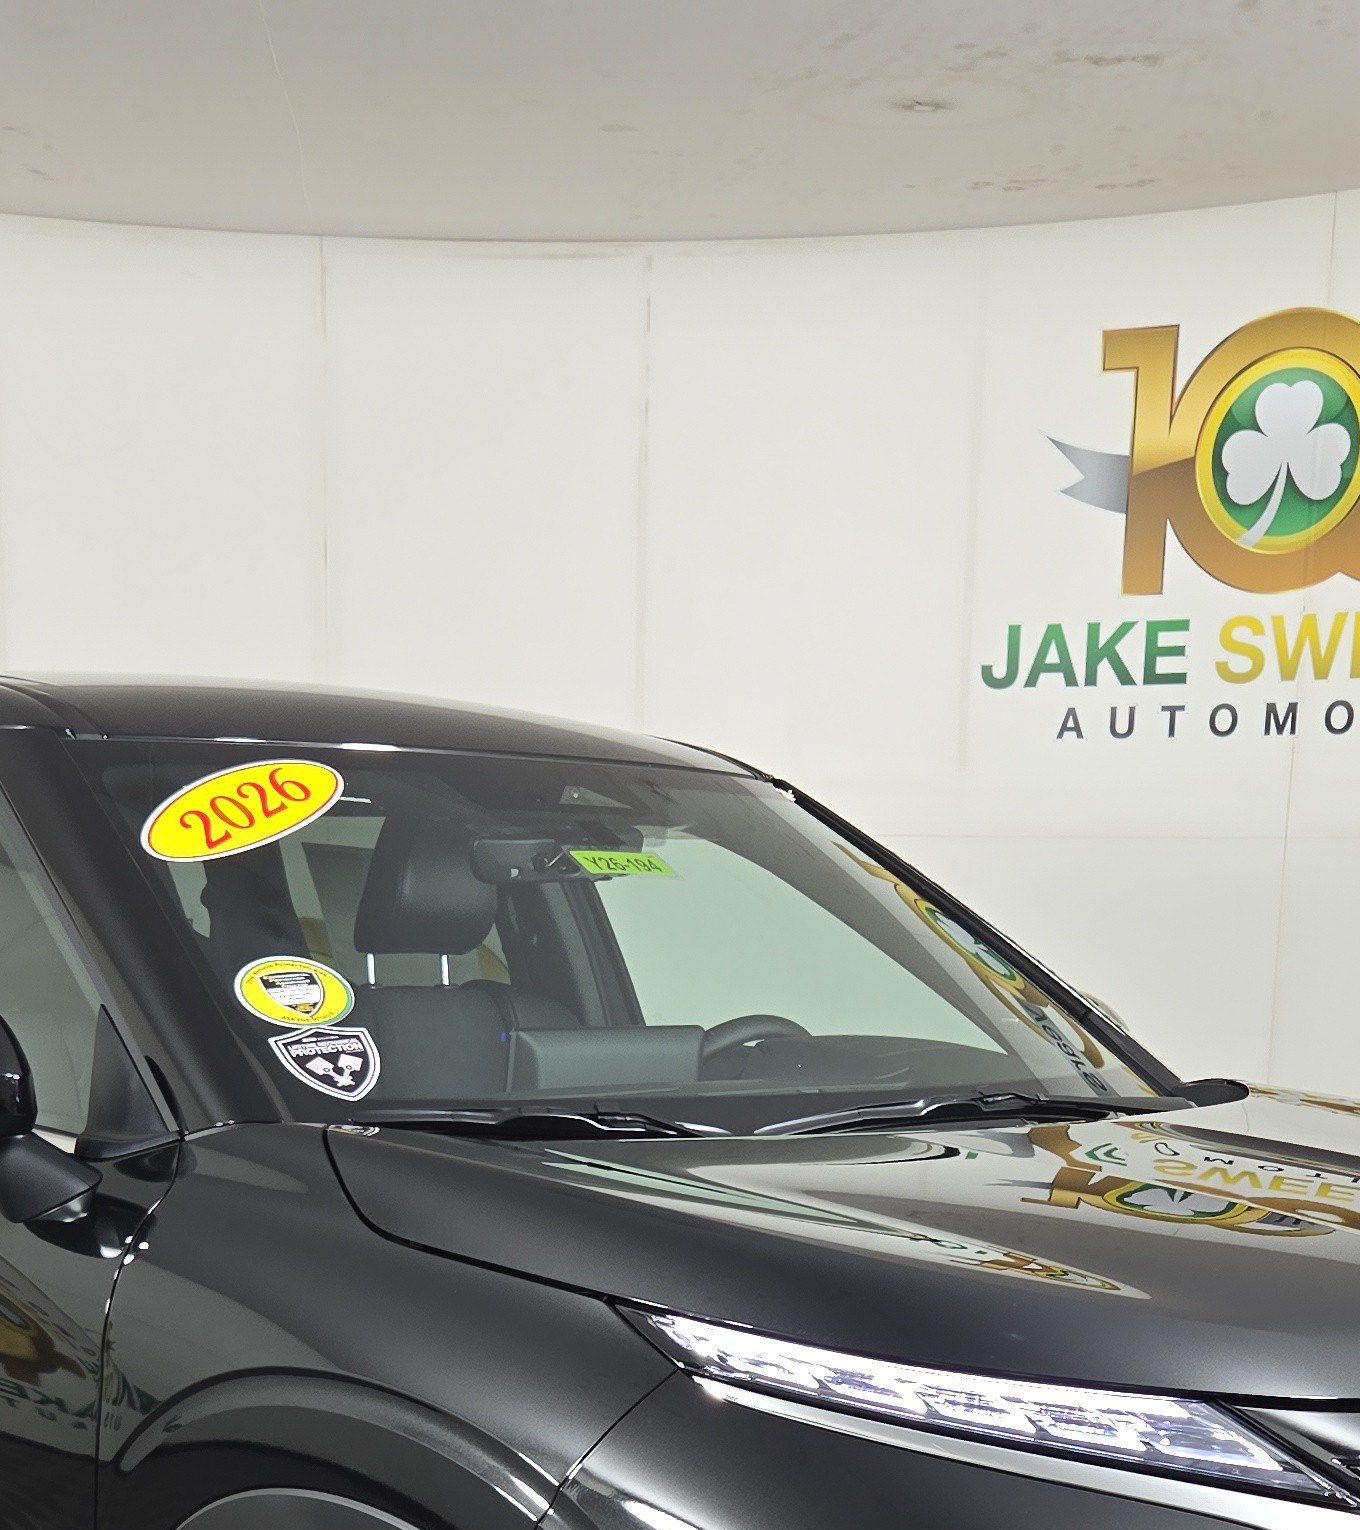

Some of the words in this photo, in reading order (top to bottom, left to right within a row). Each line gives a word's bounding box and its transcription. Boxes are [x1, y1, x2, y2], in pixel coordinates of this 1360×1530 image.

[980, 618, 1191, 692] JAKE
[179, 766, 311, 850] 2026
[290, 1043, 364, 1057] PROTECTION
